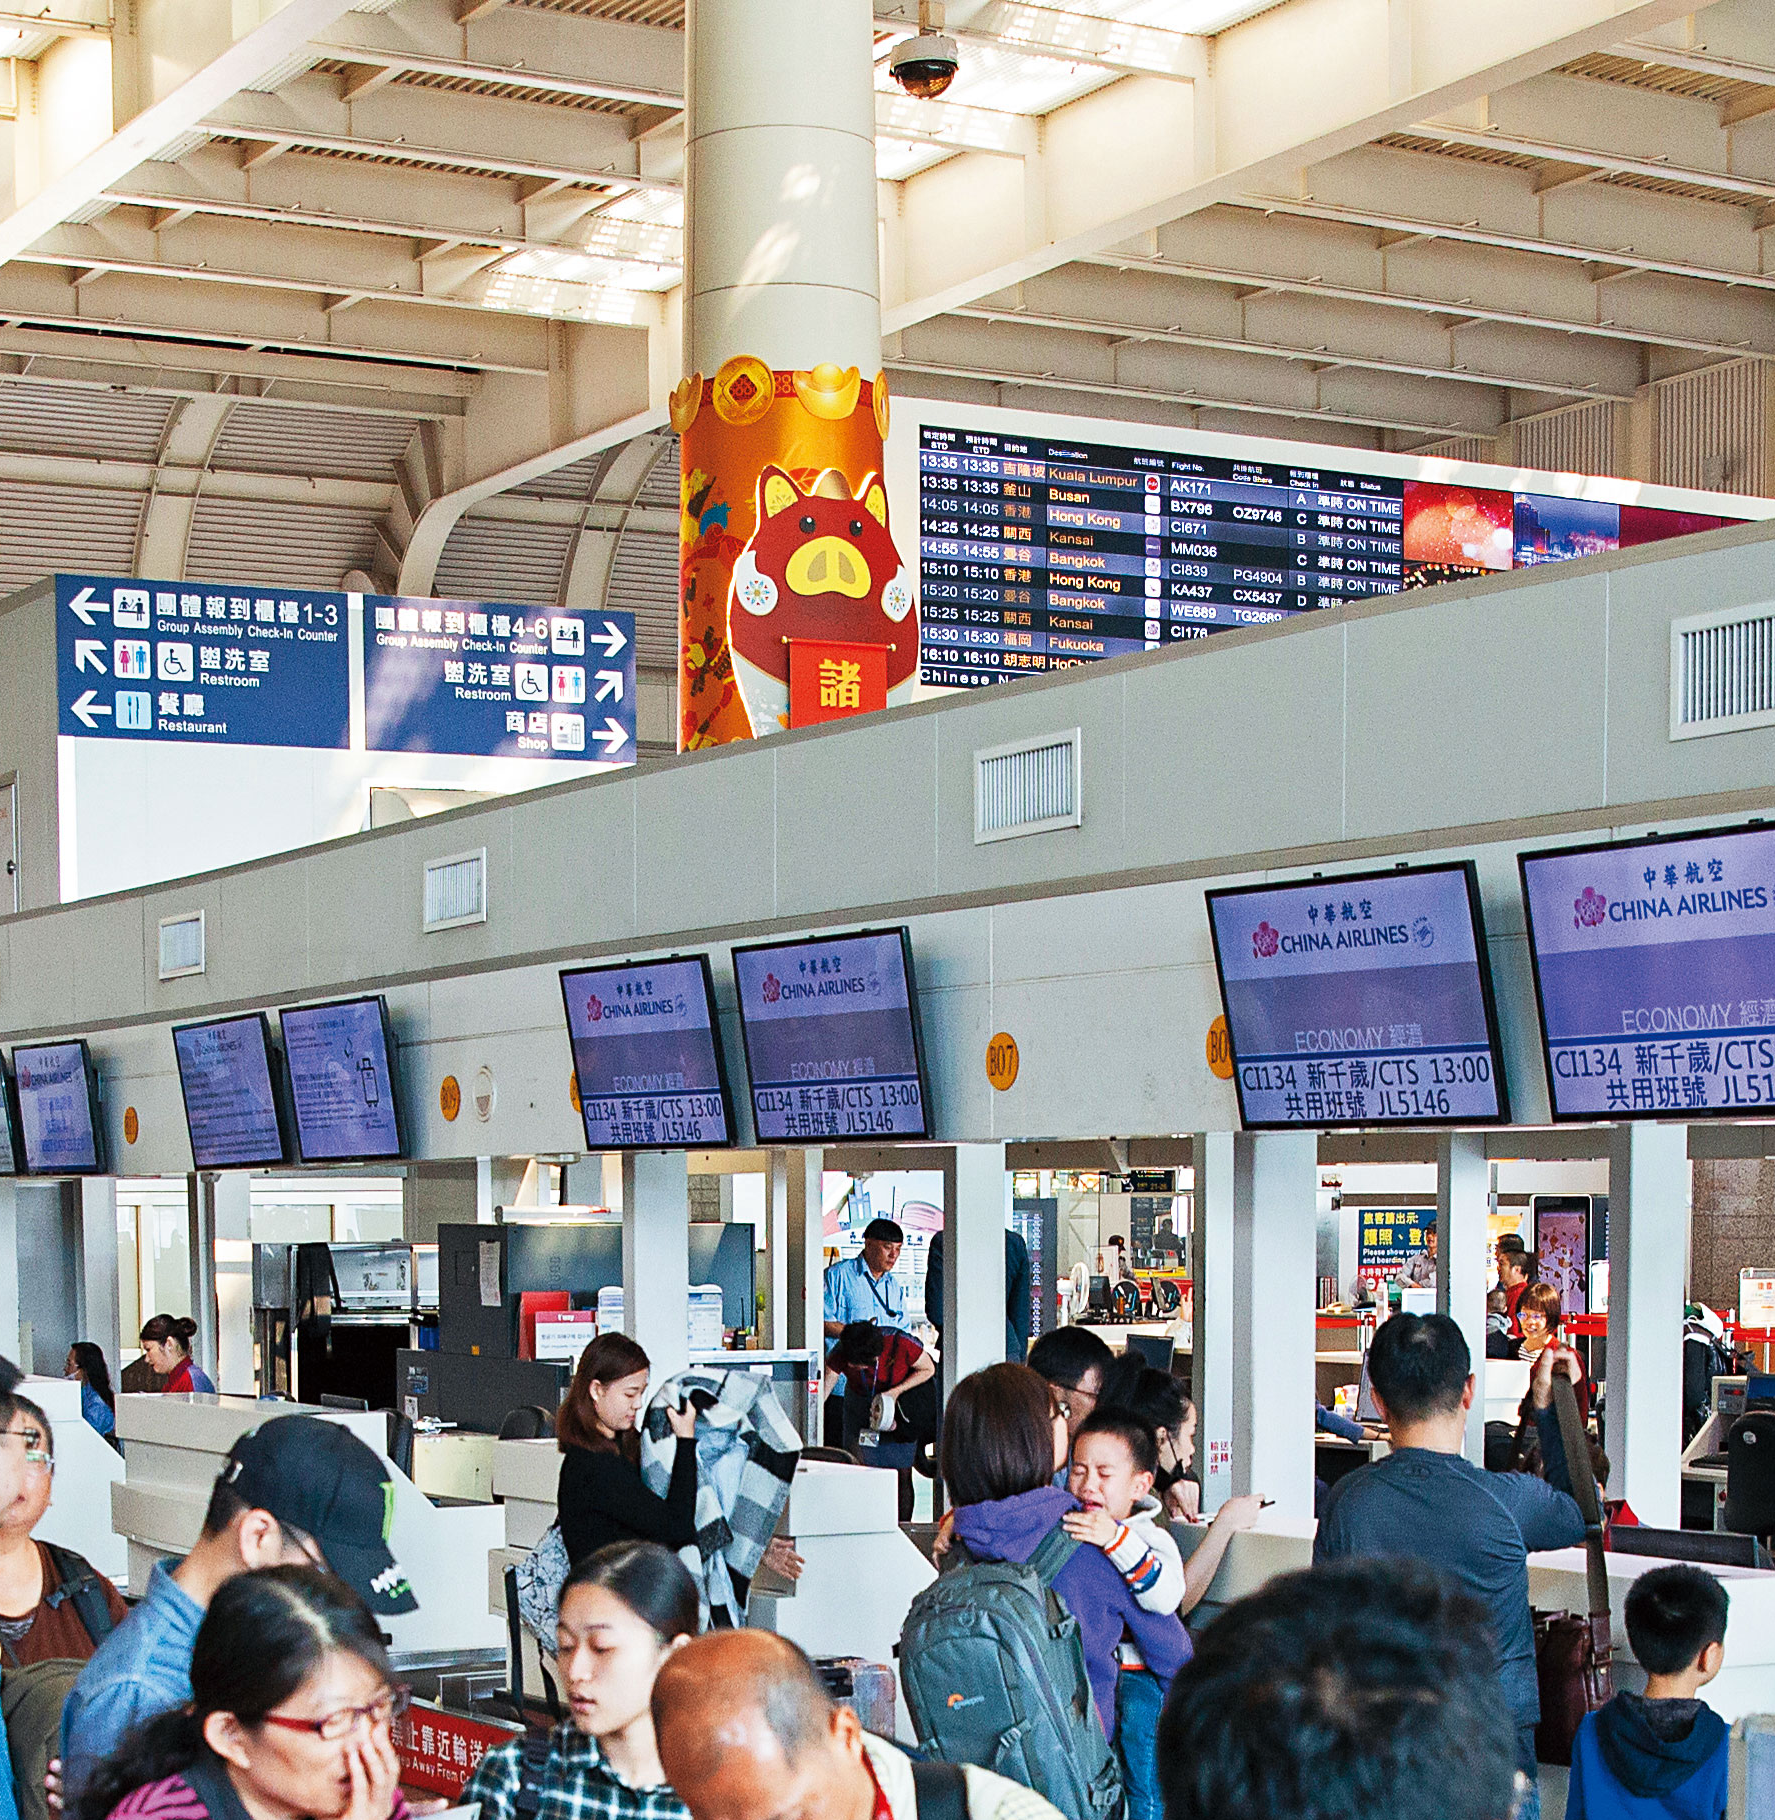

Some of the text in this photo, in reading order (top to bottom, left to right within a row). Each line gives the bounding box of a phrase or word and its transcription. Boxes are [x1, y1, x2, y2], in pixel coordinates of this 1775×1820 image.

[921, 455, 957, 469] 13:35
[1049, 469, 1085, 482] Kuala
[1090, 471, 1137, 488] Lumpur
[1171, 479, 1211, 495] AK171
[1297, 493, 1307, 505] A
[1347, 499, 1366, 512] ON
[1370, 501, 1400, 515] TIME
[922, 476, 957, 491] 13:35
[1050, 489, 1089, 503] Busan
[1171, 500, 1213, 515] BX796
[1233, 507, 1282, 522] OZ9746
[1297, 514, 1307, 525] C
[922, 498, 1207, 535] 14:05 香港 Hong Kong CI671
[922, 520, 1217, 557] 14:25 關西 Kansai MM036
[922, 541, 1282, 584] 14:55 曼谷 Bangkok CI839 PG4904
[922, 562, 1282, 604] 15:10 香港 Hong Kong KA437 CX5437
[922, 584, 957, 597] 15:20
[1004, 590, 1031, 603] 曼谷
[1050, 594, 1105, 612] Bangkok
[1171, 604, 1216, 619] WE689
[923, 606, 958, 619] 15:25
[1004, 612, 1031, 625] 關西
[1050, 616, 1093, 630] Kansai
[158, 621, 338, 642] Group Assembly Check-In Counter
[376, 634, 548, 655] Group Assembly Check-In Counter
[923, 627, 1104, 651] 15:30 福岡 Fukuoka
[200, 647, 270, 672] 盥洗室
[922, 648, 958, 661] 16:10
[1004, 654, 1045, 668] 胡志明
[201, 674, 260, 687] Restroom
[444, 661, 510, 686] 盥洗室
[819, 658, 861, 708] 諸
[920, 669, 989, 685] Chinese
[159, 692, 204, 716] 餐廳
[455, 688, 511, 701] Restroom
[159, 720, 227, 733] Restaurant
[506, 712, 548, 734] 商店
[518, 737, 548, 751] Shop
[1643, 859, 1723, 890] 中華航空
[1307, 899, 1373, 926] 中華航空
[1609, 887, 1767, 922] CHINA AIRLINES
[1281, 925, 1408, 953] CHINA AIRLINES
[782, 977, 865, 1000] CHINA AIRLINES
[603, 1000, 673, 1020] CHINA AIRLINES
[1622, 1004, 1731, 1032] ECONOMY
[1211, 1030, 1229, 1063] B0
[1295, 1023, 1423, 1051] ECONOMY 經濟
[990, 1045, 1013, 1076] B07
[1556, 1049, 1622, 1078] CI134
[1636, 1040, 1774, 1074] 新千歲/CTS
[1243, 1056, 1489, 1090] CI134 新千歲/CTS 13:00
[757, 1092, 793, 1112] CI134
[881, 1083, 919, 1105] 13:00
[1285, 1089, 1450, 1119] 共用班號 JL5146
[1606, 1077, 1707, 1109] 共用班號
[586, 1101, 617, 1122] CI134
[690, 1097, 721, 1117] 13:00
[662, 1120, 701, 1140] JL5146
[785, 1110, 893, 1136] 共用班號 JL5146
[1364, 1228, 1427, 1245] 護照、登
[412, 1759, 435, 1777] Away
[437, 1765, 458, 1782] From
